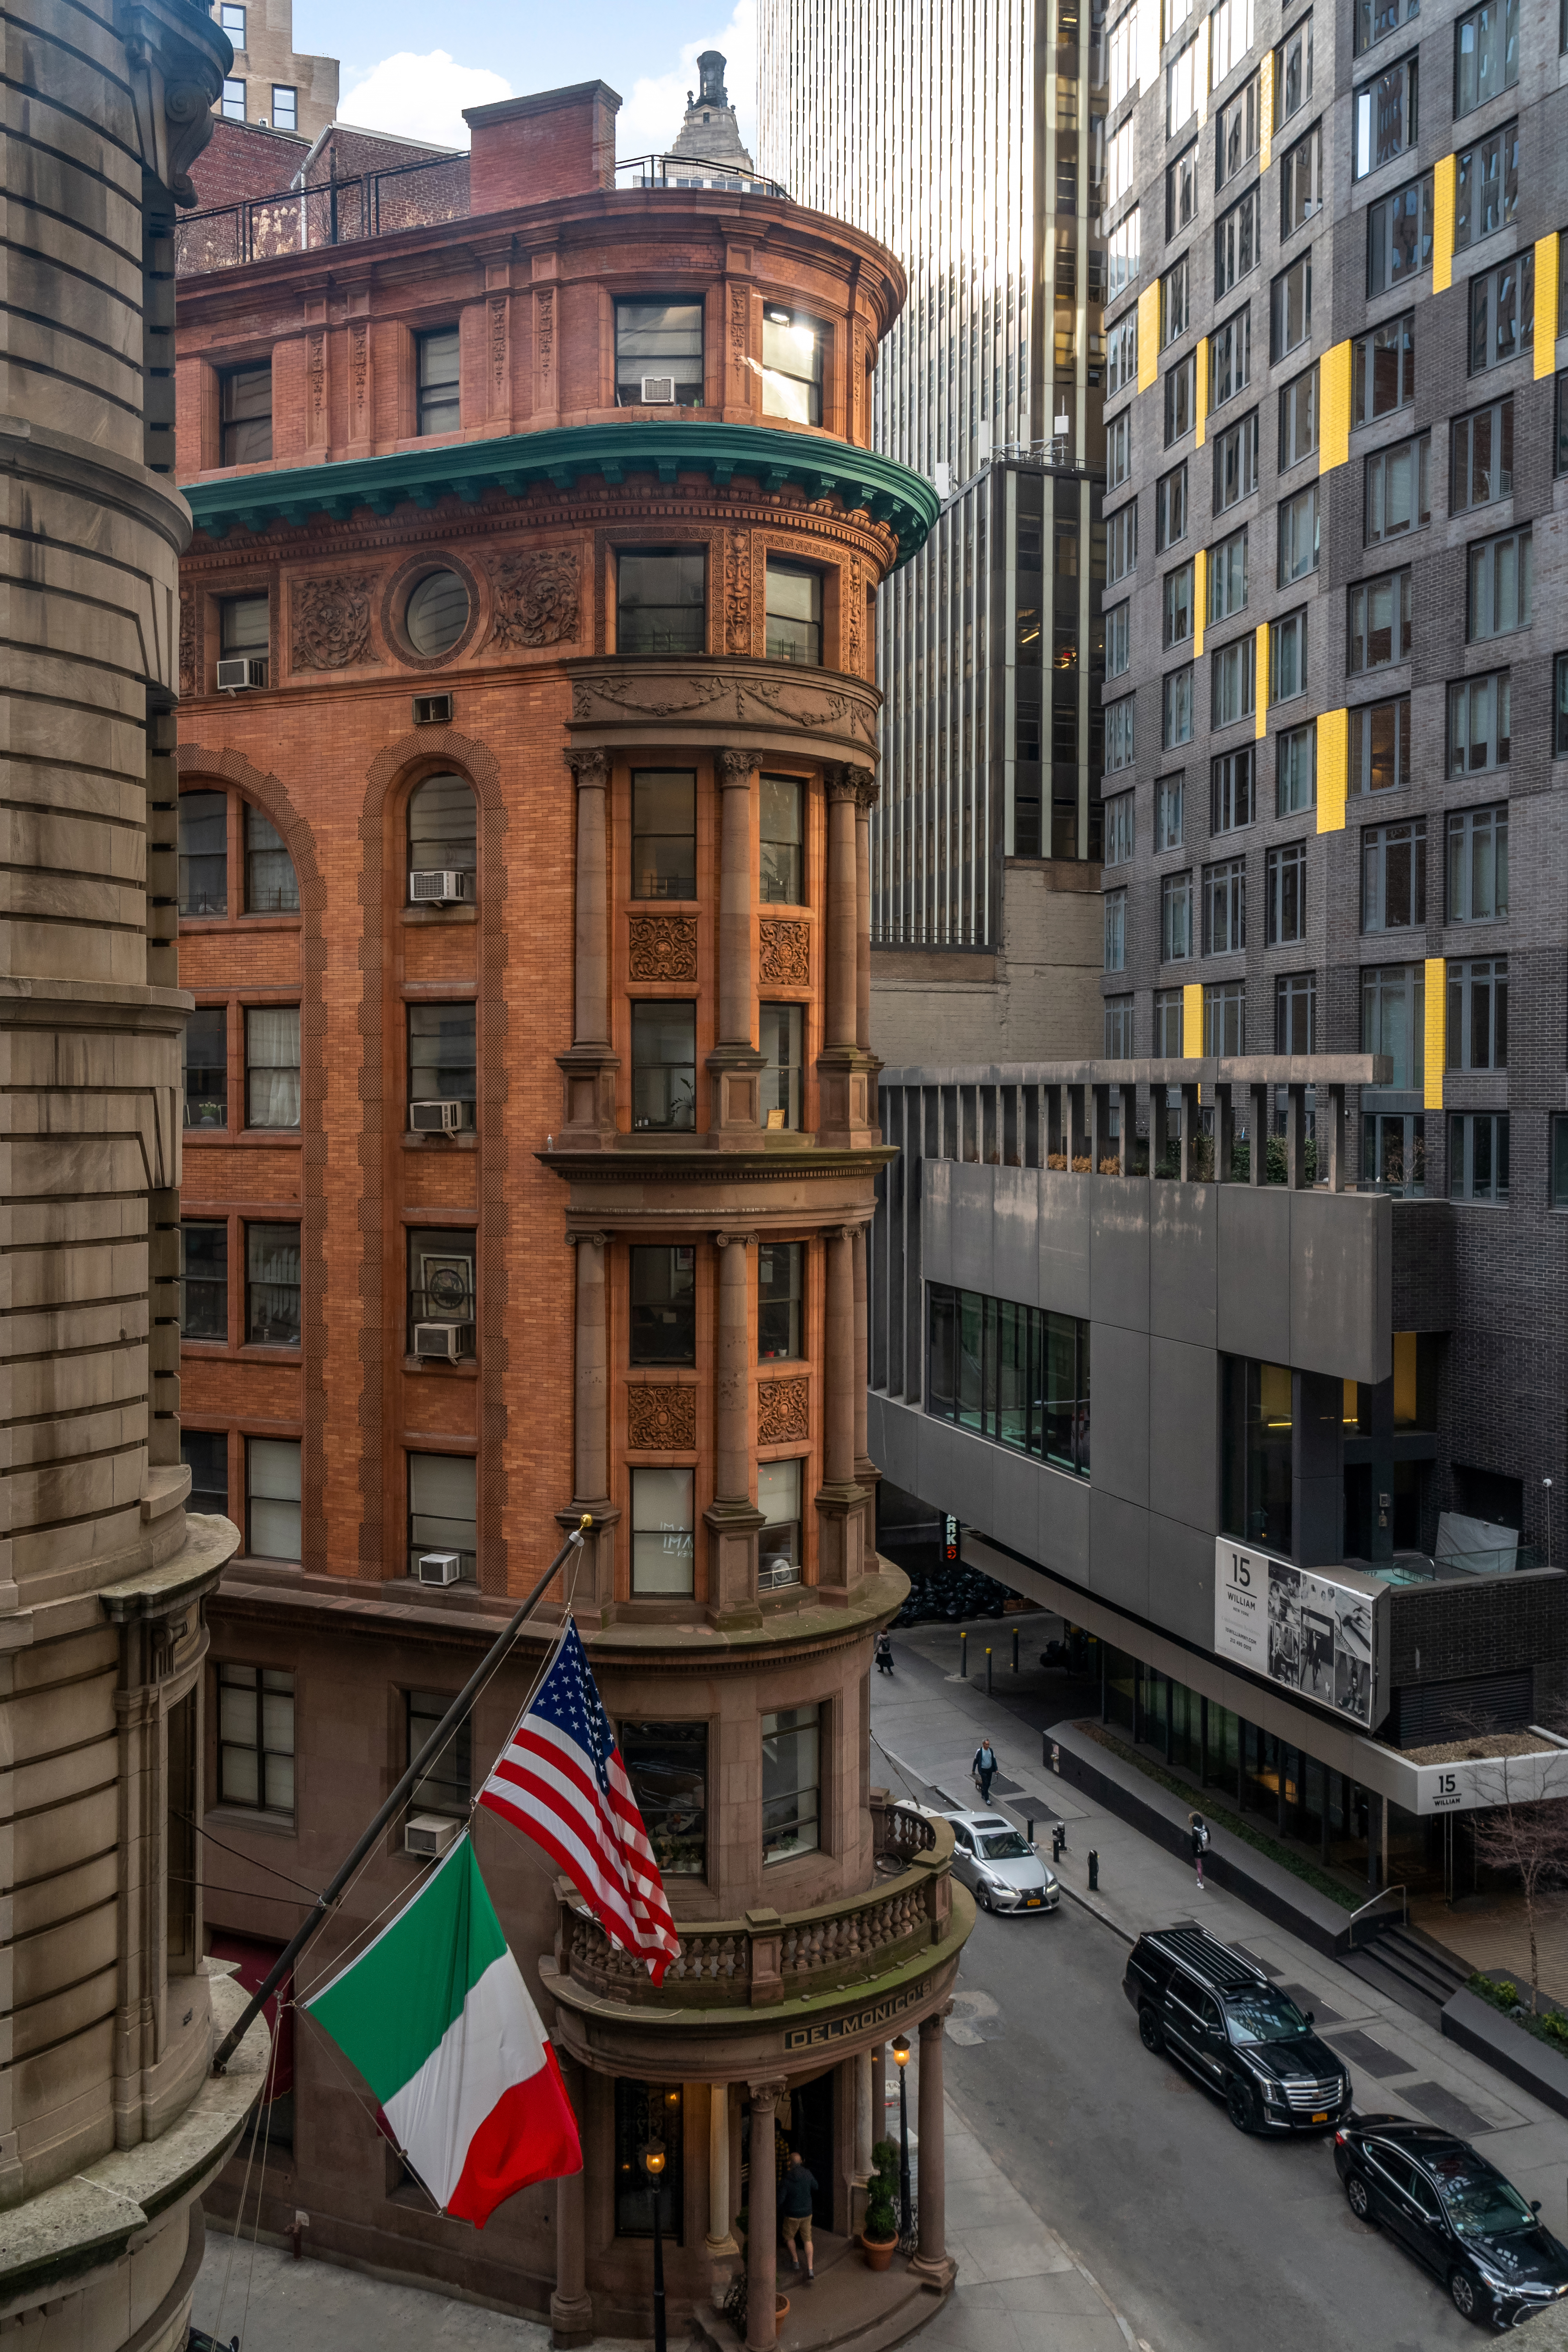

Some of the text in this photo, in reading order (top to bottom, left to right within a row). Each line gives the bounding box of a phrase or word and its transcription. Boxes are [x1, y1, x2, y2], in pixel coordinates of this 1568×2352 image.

[1232, 1553, 1250, 1587] 15
[1227, 1591, 1255, 1611] WILLIAM
[1225, 1627, 1256, 1645] 15WILLIAMNY.COM
[1439, 1774, 1455, 1793] 15
[1434, 1798, 1460, 1806] WILLIAM
[791, 1980, 931, 2048] DELMONICO'S
